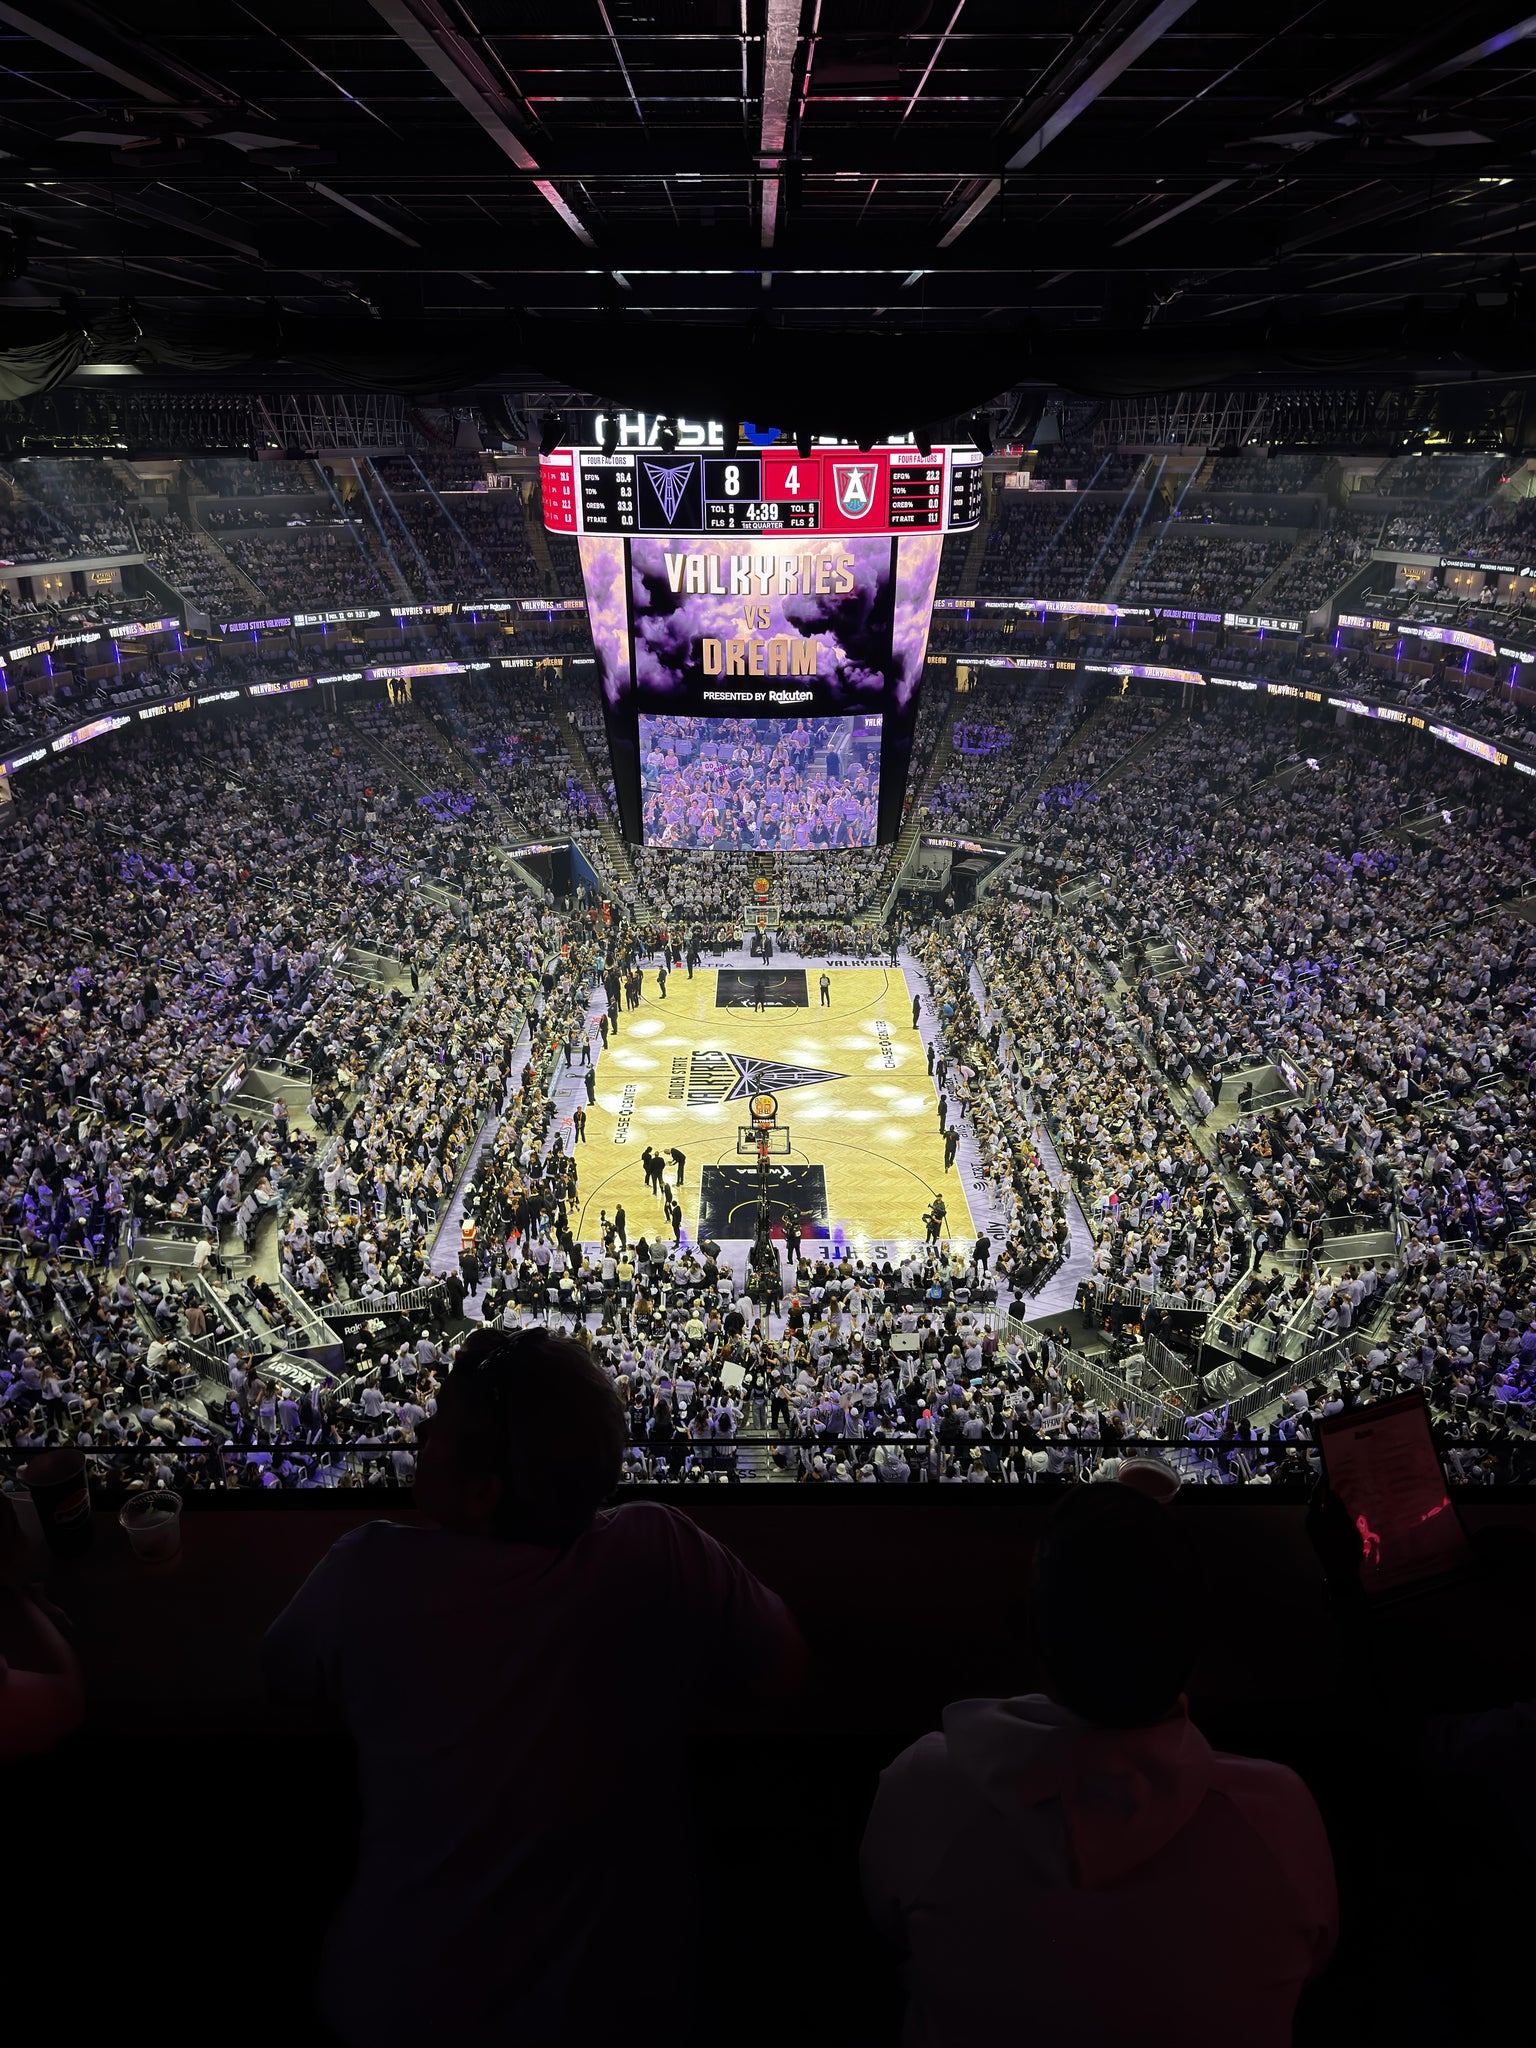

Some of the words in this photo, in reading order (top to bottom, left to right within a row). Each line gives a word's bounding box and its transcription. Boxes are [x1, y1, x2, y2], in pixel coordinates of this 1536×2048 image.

[587, 456, 601, 465] FOUR
[898, 455, 913, 463] FOUR
[724, 465, 740, 496] 8
[784, 465, 801, 495] 4
[711, 505, 726, 513] TOL
[728, 504, 735, 514] 5
[746, 503, 779, 521] 4:39
[790, 504, 806, 513] TOL
[808, 503, 815, 514] 5
[711, 519, 725, 527] FLS
[728, 518, 735, 528] 2
[808, 517, 815, 528] 2
[663, 553, 856, 595] VALKYRIES
[391, 605, 423, 617] VALKYRIES
[521, 600, 554, 610] VALKYRIES
[563, 600, 584, 609] DREAM
[743, 604, 771, 629] VS
[501, 659, 534, 669] VALKYRIES
[703, 638, 818, 677] DREAM
[1016, 658, 1048, 669] VALKYRIES
[1056, 661, 1076, 671] DREAM
[250, 682, 281, 696] VALKYRIES
[703, 691, 754, 701] PRESENTED
[754, 692, 766, 701] BY
[769, 690, 814, 705] Rakuten
[672, 1056, 688, 1075] STATE
[881, 1047, 896, 1069] CHASE
[668, 1076, 686, 1099] GOLDEN
[686, 1050, 737, 1107] VALKYRIES
[621, 1084, 637, 1109] CENTER
[614, 1117, 631, 1144] CHASE
[985, 1221, 1007, 1241] ally
